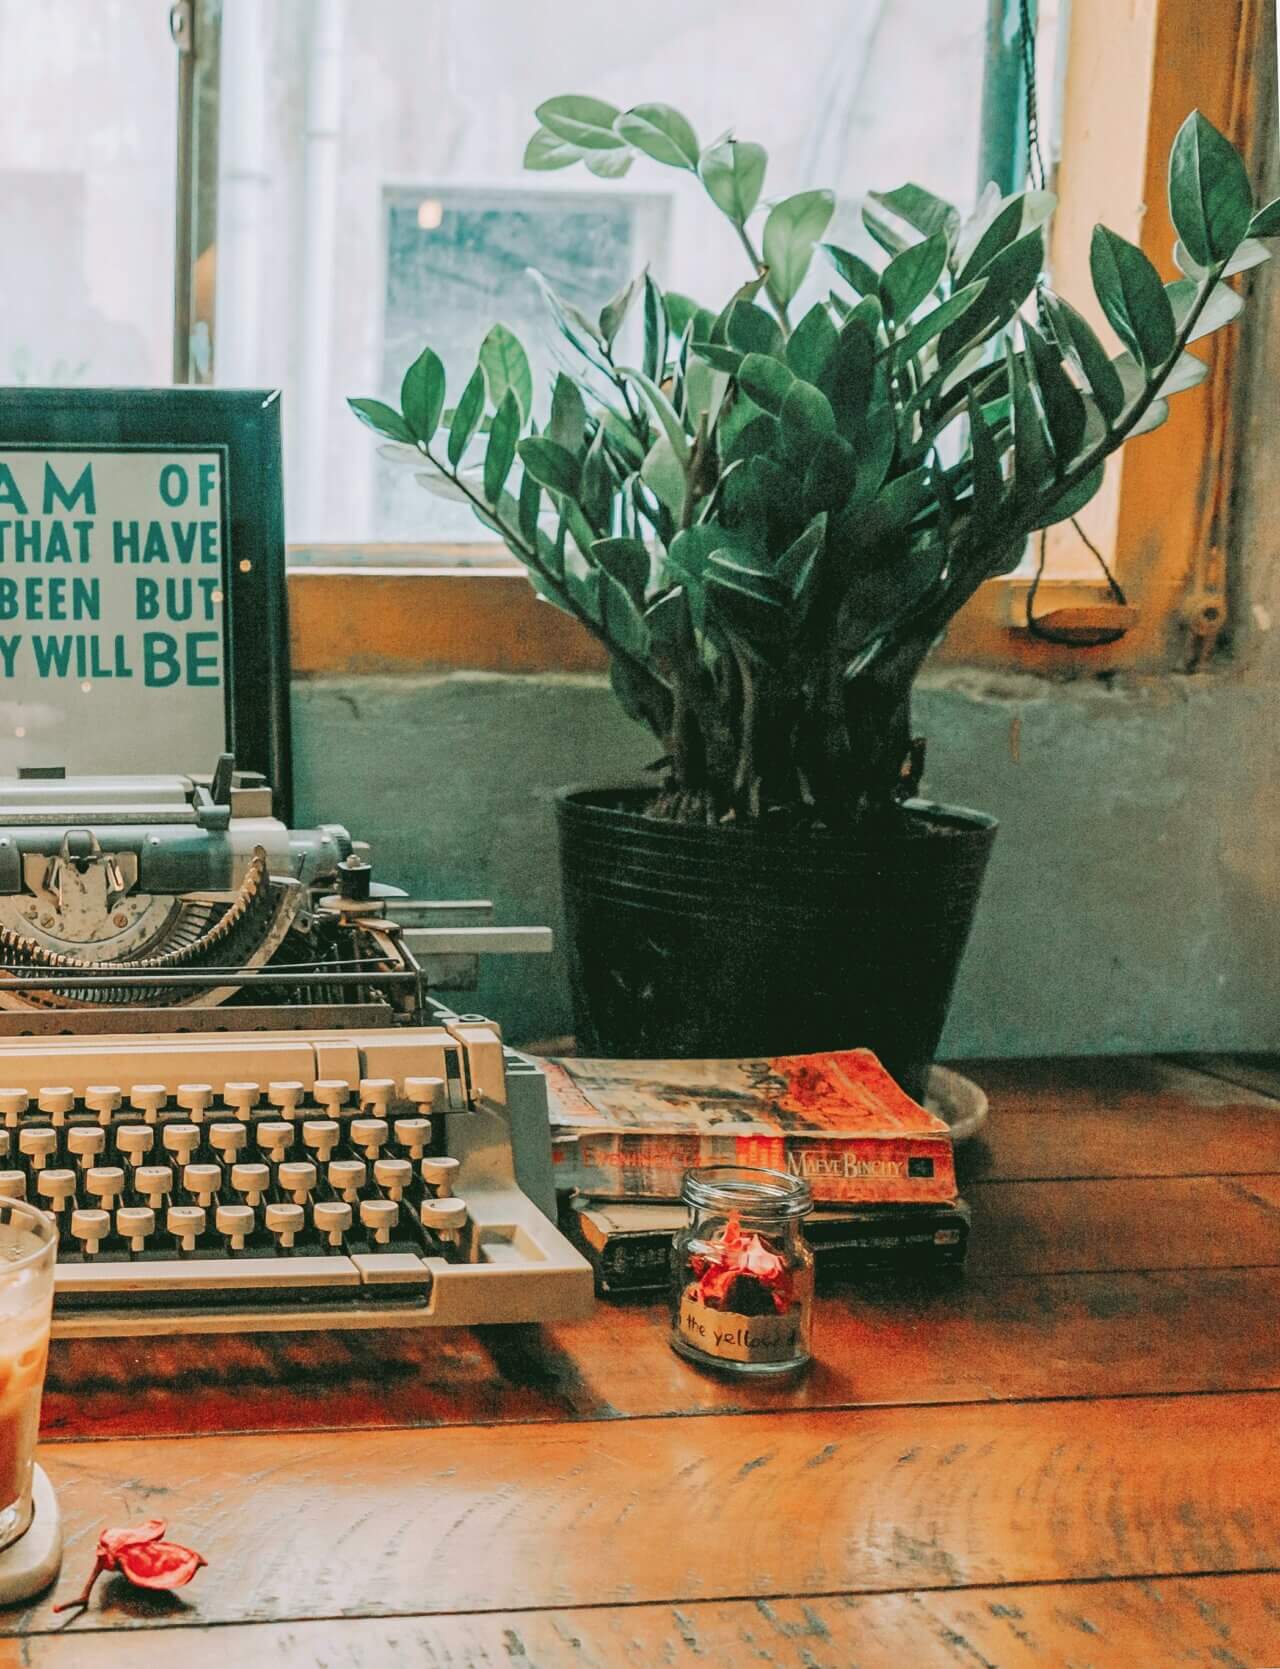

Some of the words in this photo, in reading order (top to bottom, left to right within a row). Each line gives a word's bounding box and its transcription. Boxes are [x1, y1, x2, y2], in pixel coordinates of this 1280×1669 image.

[159, 463, 216, 508] OF
[113, 520, 218, 564] HAVE
[136, 577, 219, 621] BUT
[32, 634, 133, 679] WILL
[143, 631, 220, 688] BE
[687, 1313, 706, 1337] the
